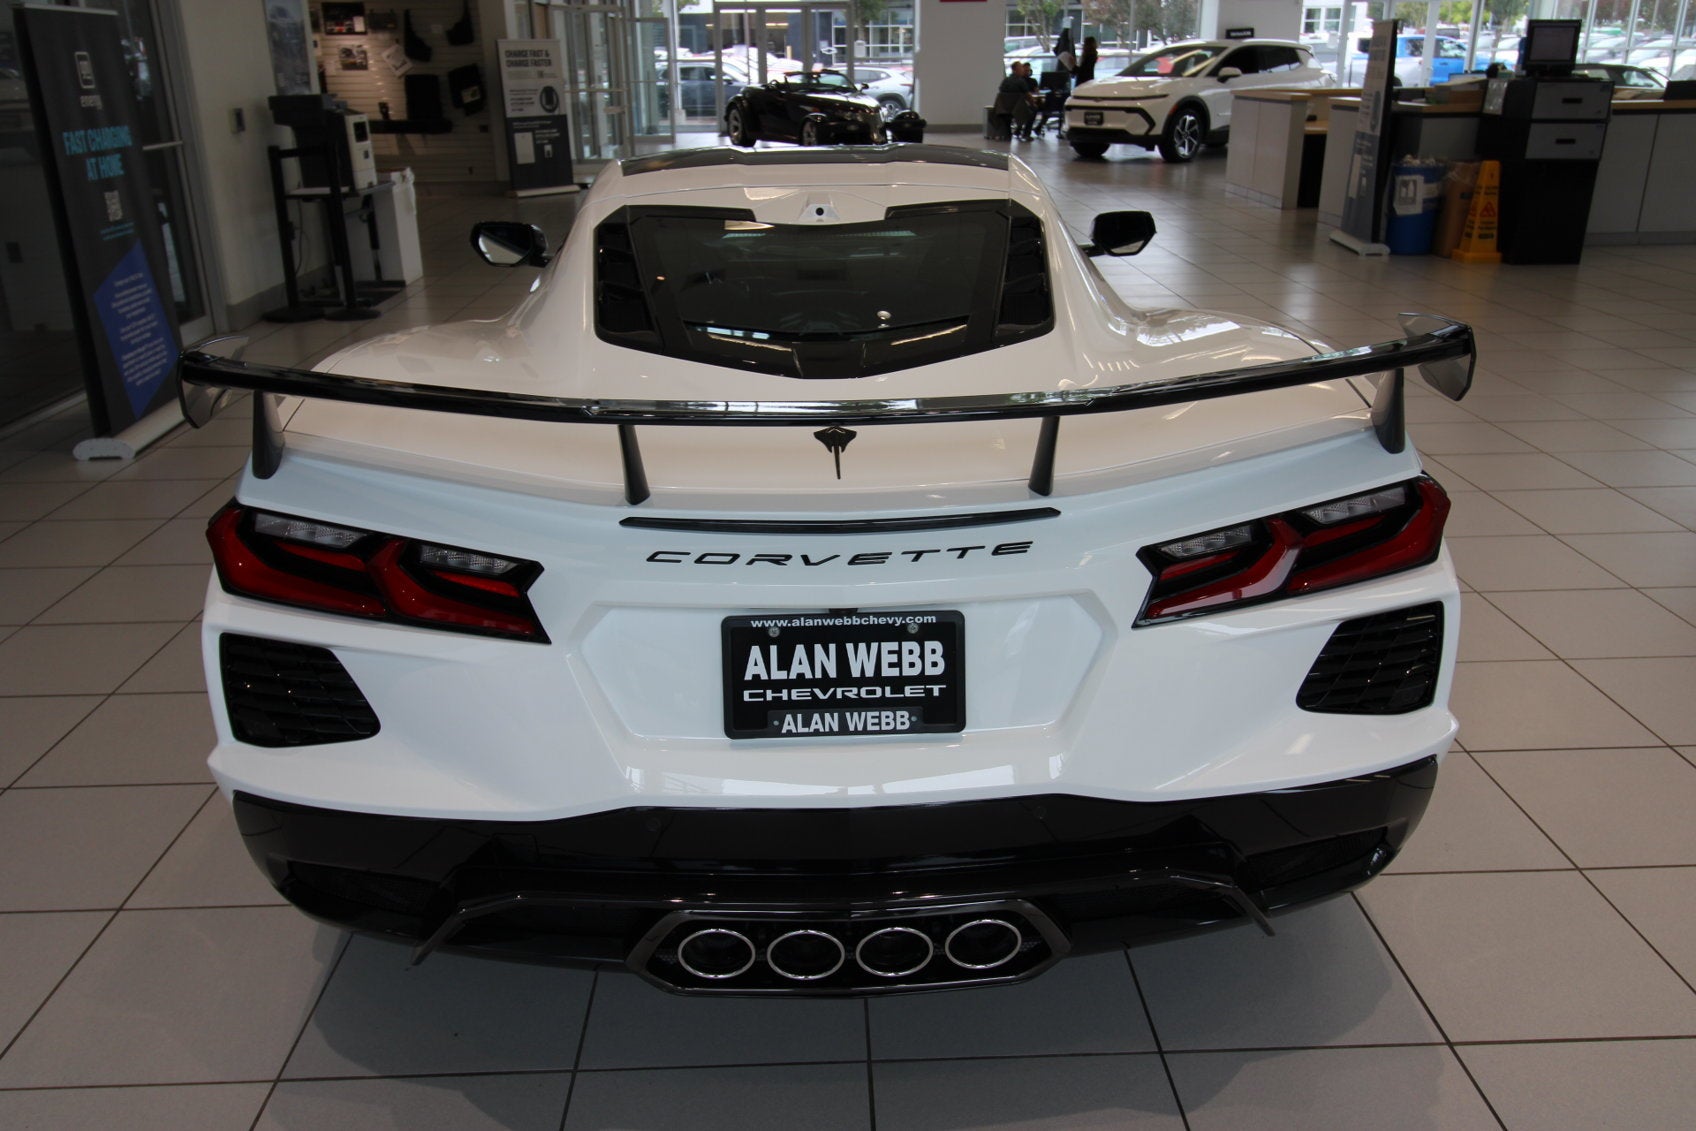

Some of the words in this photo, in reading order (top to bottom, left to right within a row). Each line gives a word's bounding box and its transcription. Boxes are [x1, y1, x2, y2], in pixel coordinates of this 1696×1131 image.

[62, 129, 87, 155] FAST
[86, 157, 98, 181] AT
[98, 153, 125, 180] HOME
[646, 540, 1034, 567] CORVETTE
[750, 614, 937, 628] www.alanwebbchevy.com
[744, 643, 837, 681] ALAN
[846, 640, 946, 677] WEBB
[743, 683, 947, 702] CHEVROLET
[781, 711, 839, 734] ALAN
[845, 710, 911, 732] WEBB
